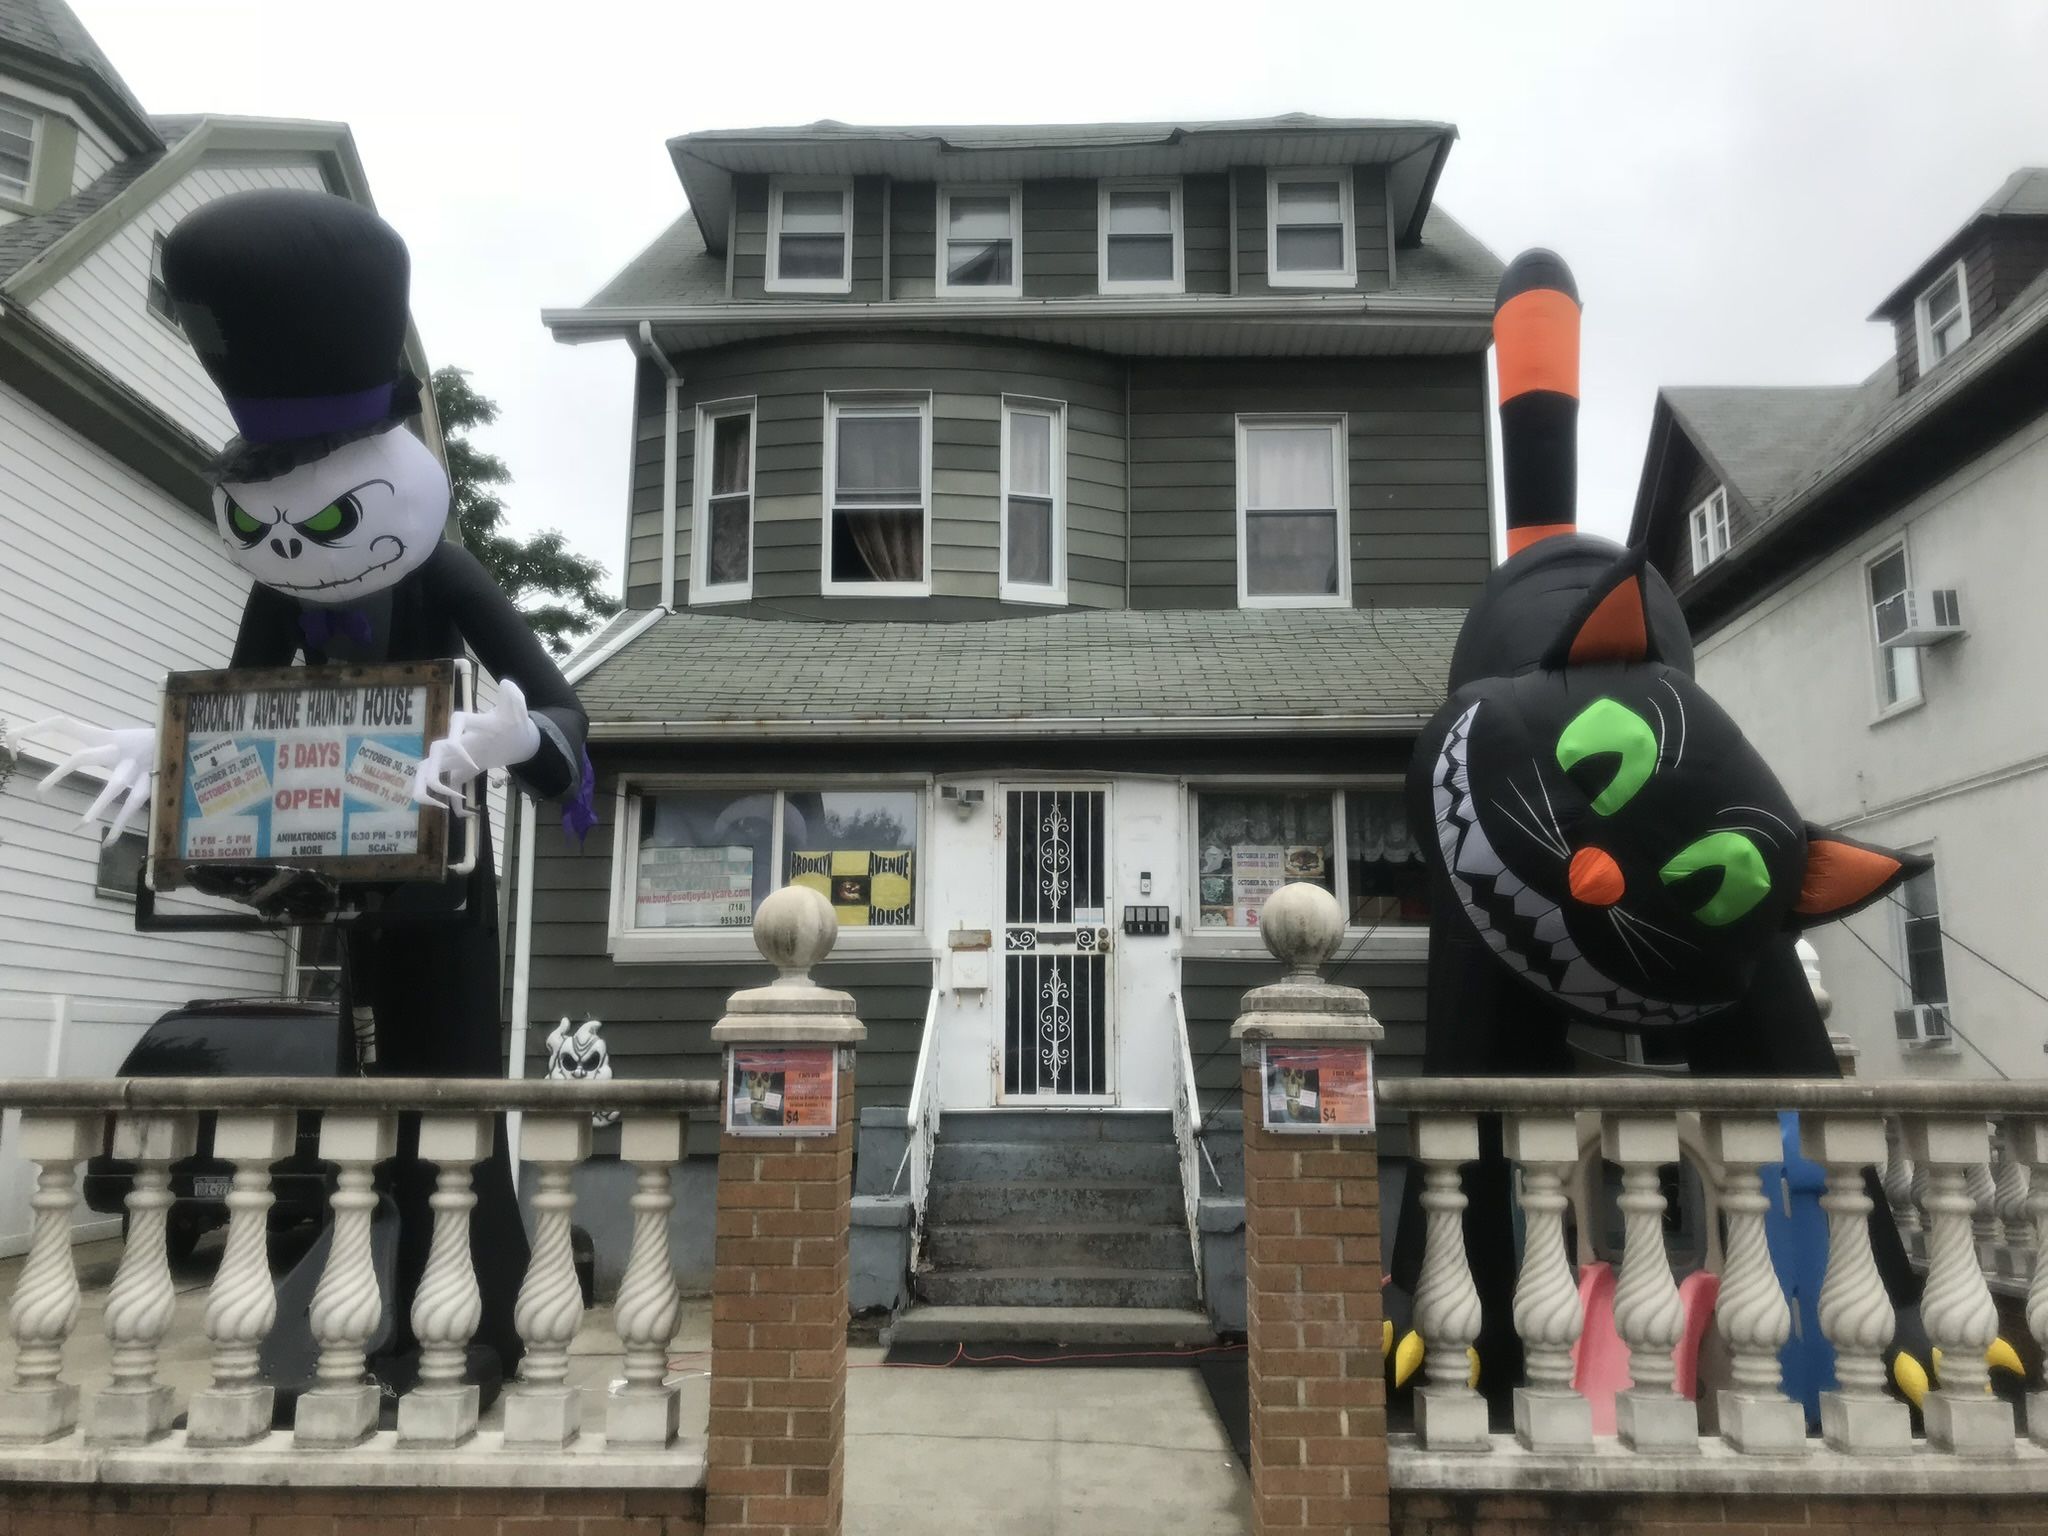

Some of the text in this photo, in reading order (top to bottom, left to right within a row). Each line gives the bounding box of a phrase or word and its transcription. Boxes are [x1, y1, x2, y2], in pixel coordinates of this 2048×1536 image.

[189, 687, 414, 732] BROOKLYN AVENUE HAUNTED HOUSE
[193, 739, 232, 761] Starting
[278, 742, 340, 769] 5 DAYS
[358, 746, 393, 767] OCTOBER
[194, 768, 227, 791] OCTOBER
[240, 753, 257, 768] 2017
[198, 781, 232, 804] OCTOBER
[275, 788, 340, 810] OPEN
[201, 836, 216, 845] PM
[235, 834, 251, 844] PM
[276, 831, 337, 842] ANIMATRONICS
[373, 831, 386, 840] PM
[403, 830, 417, 839] PM
[188, 847, 252, 858] LESS SCARY
[300, 845, 322, 855] MORE
[368, 844, 399, 853] SCARY
[791, 851, 909, 880] BROOKLYN AVENUE
[728, 903, 746, 912] (718)
[869, 904, 910, 926] HOUSE
[785, 1110, 799, 1124] $4
[1323, 1107, 1337, 1121] $4
